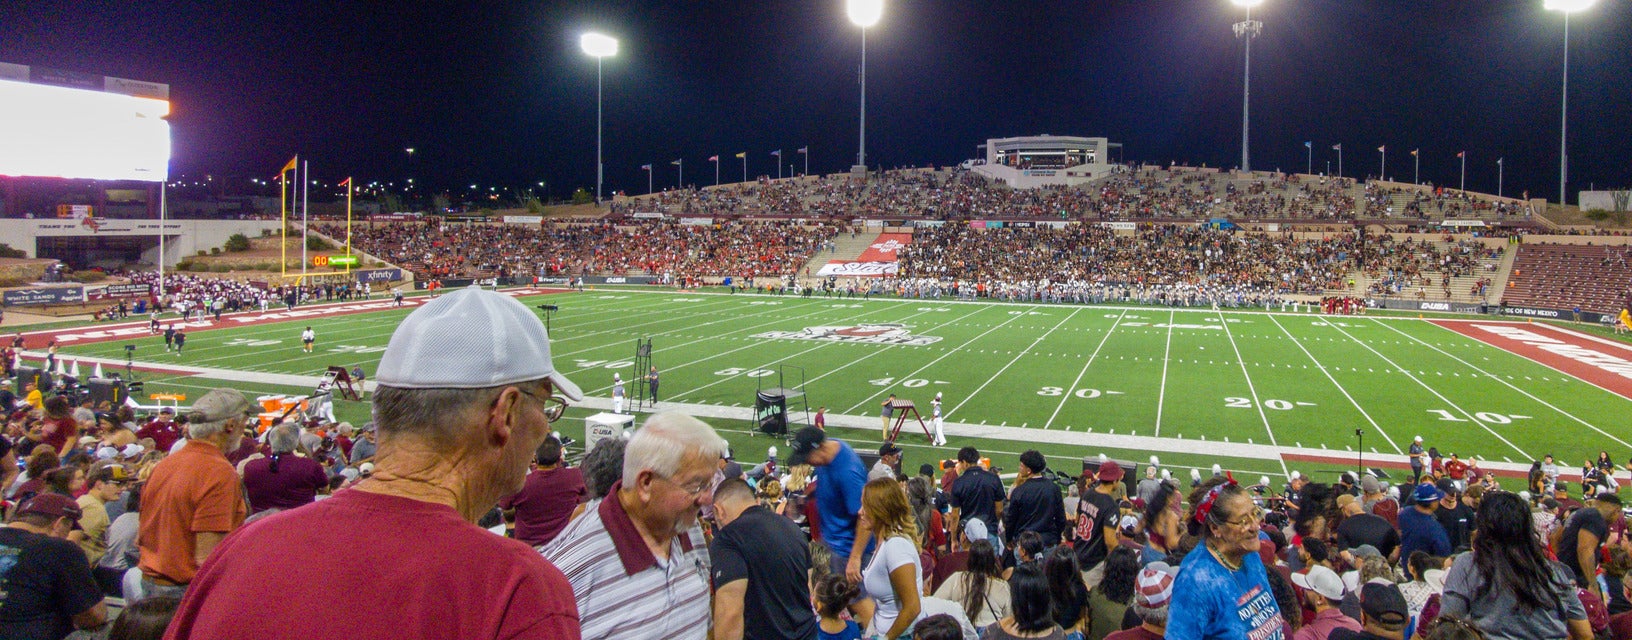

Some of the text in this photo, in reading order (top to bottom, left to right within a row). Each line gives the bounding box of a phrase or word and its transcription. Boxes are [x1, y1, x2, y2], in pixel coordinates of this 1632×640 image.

[367, 271, 393, 281] xfinity
[1036, 386, 1101, 398] 30
[1224, 396, 1294, 410] 20
[1426, 409, 1512, 424] 10
